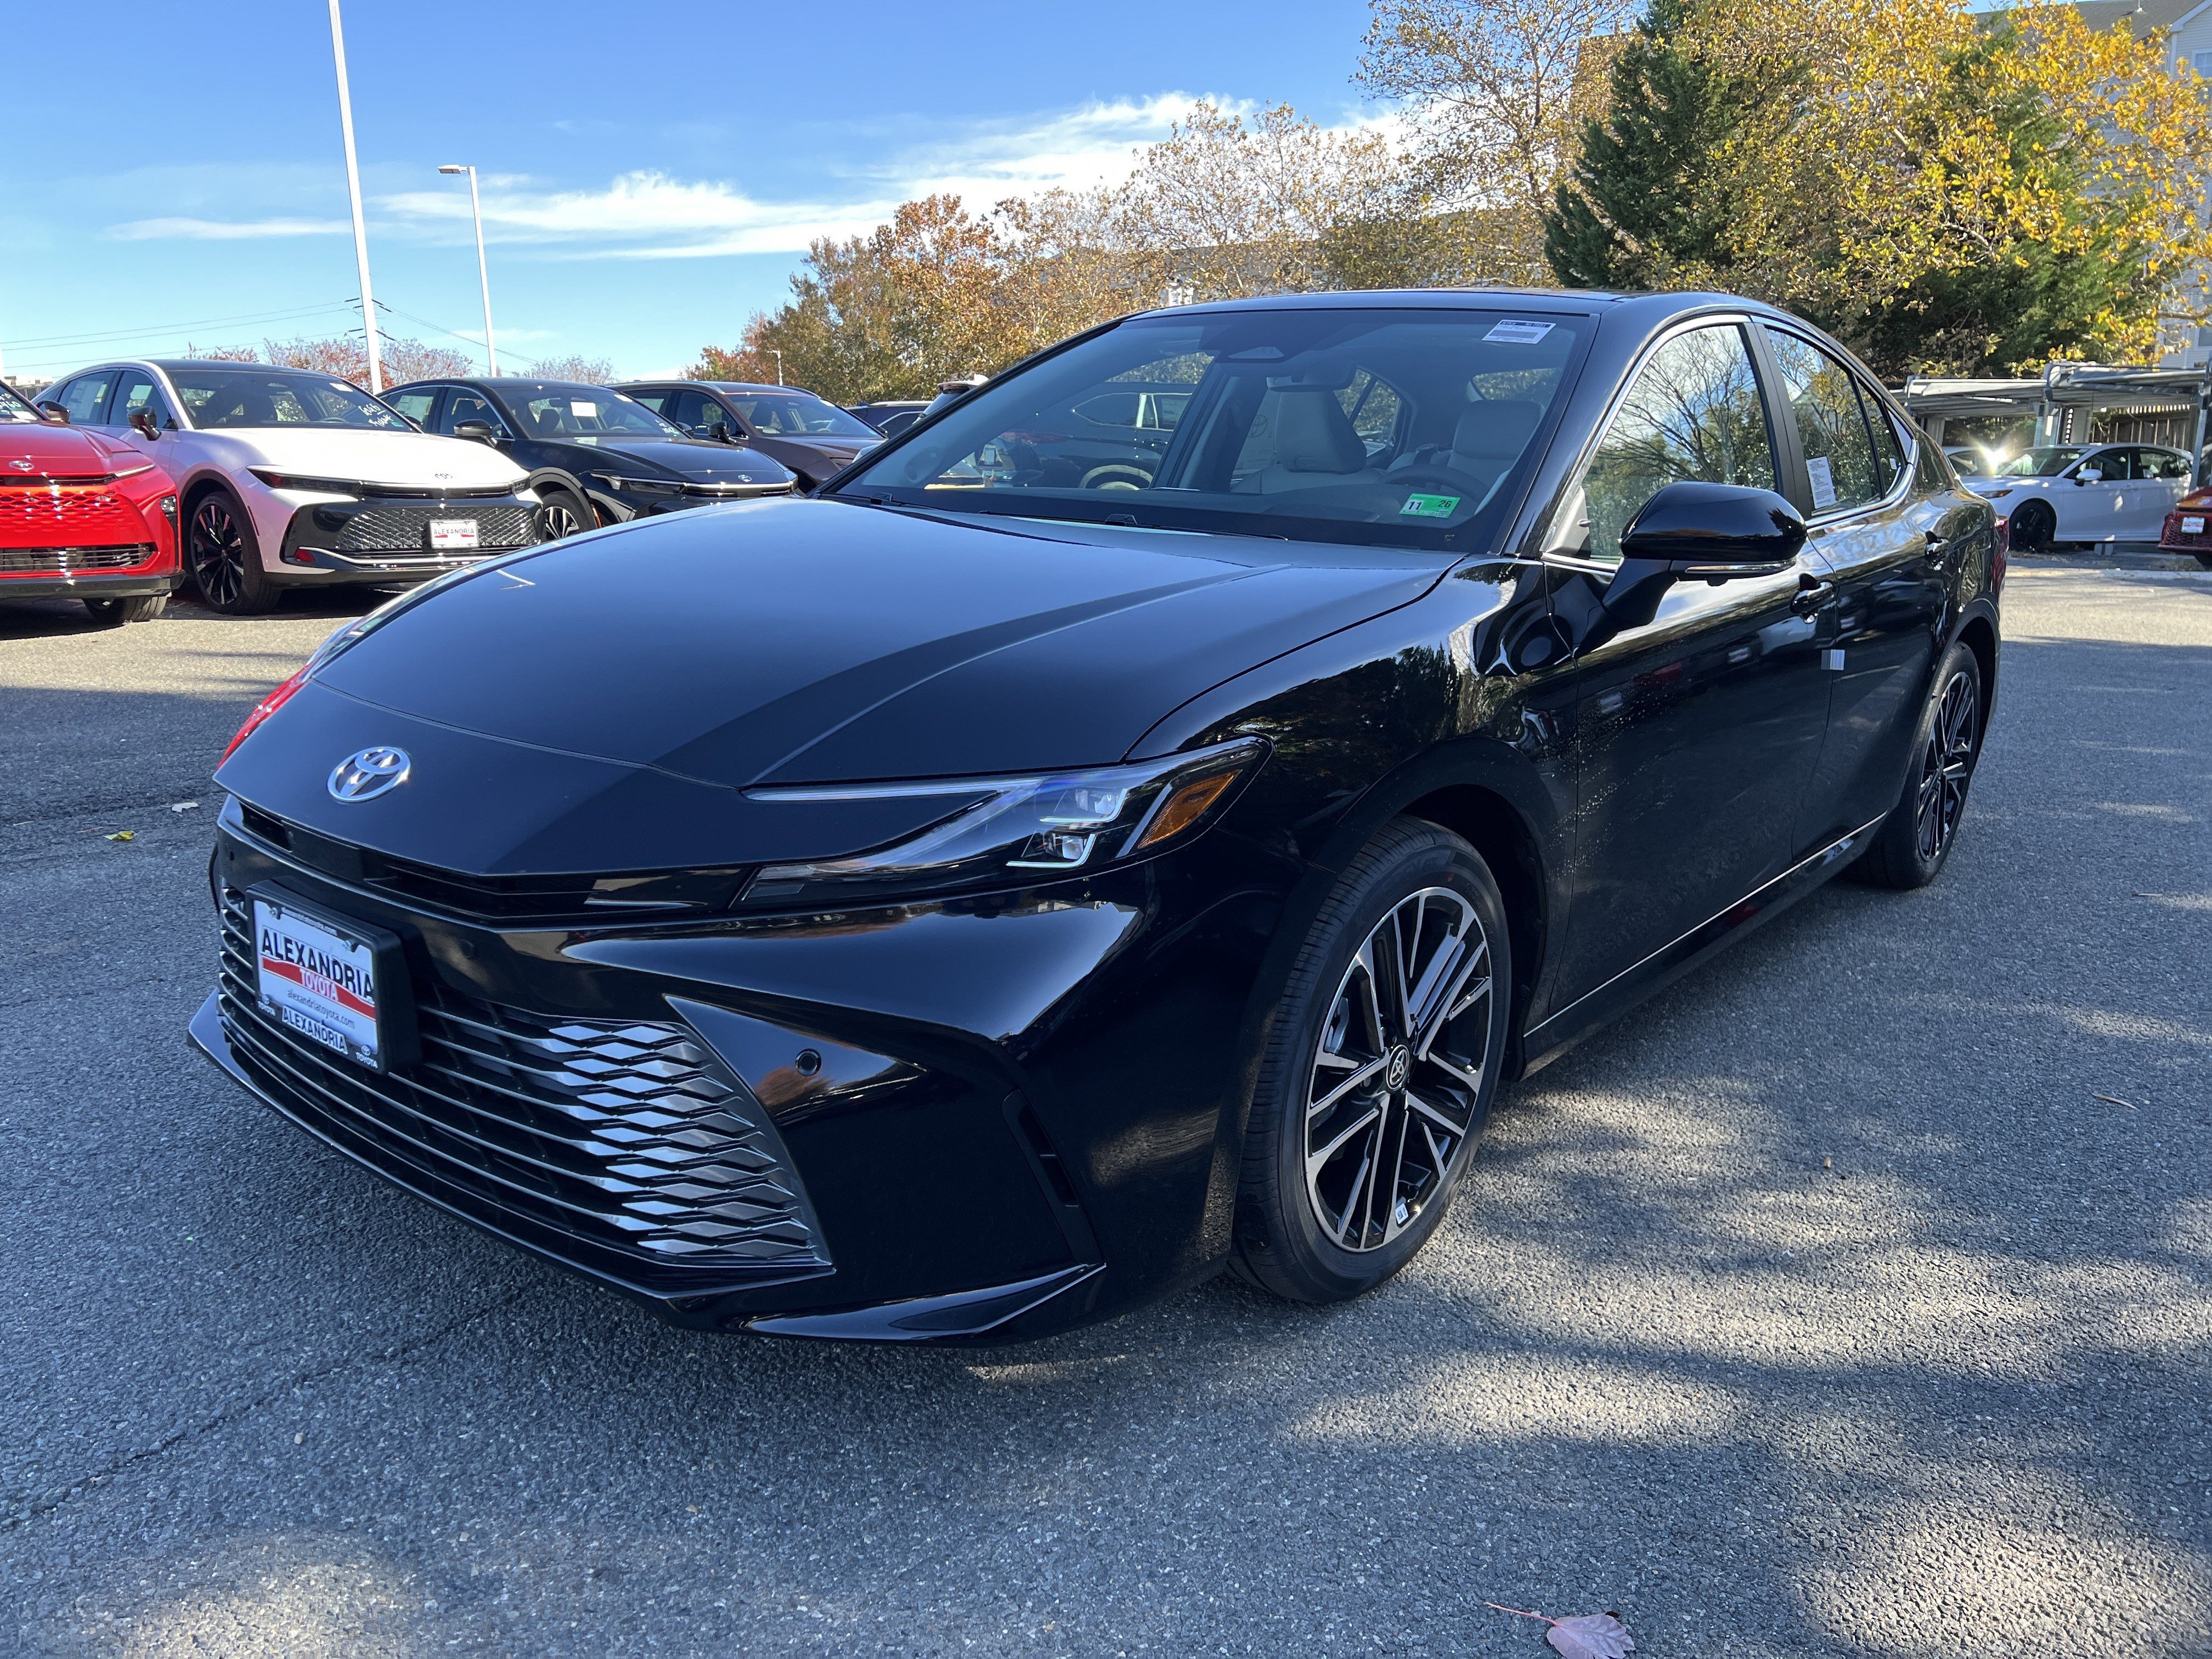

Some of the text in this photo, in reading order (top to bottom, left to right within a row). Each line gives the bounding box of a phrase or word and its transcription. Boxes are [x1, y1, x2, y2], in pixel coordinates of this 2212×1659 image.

[1408, 501, 1422, 510] 11
[262, 928, 375, 998] ALEXANDRIA
[301, 969, 338, 1002] TOYOTA
[287, 990, 355, 1029] alexandriatoyota.com
[283, 1007, 347, 1053] ALEXANDRIA
[356, 1052, 378, 1068] TOYOTA
